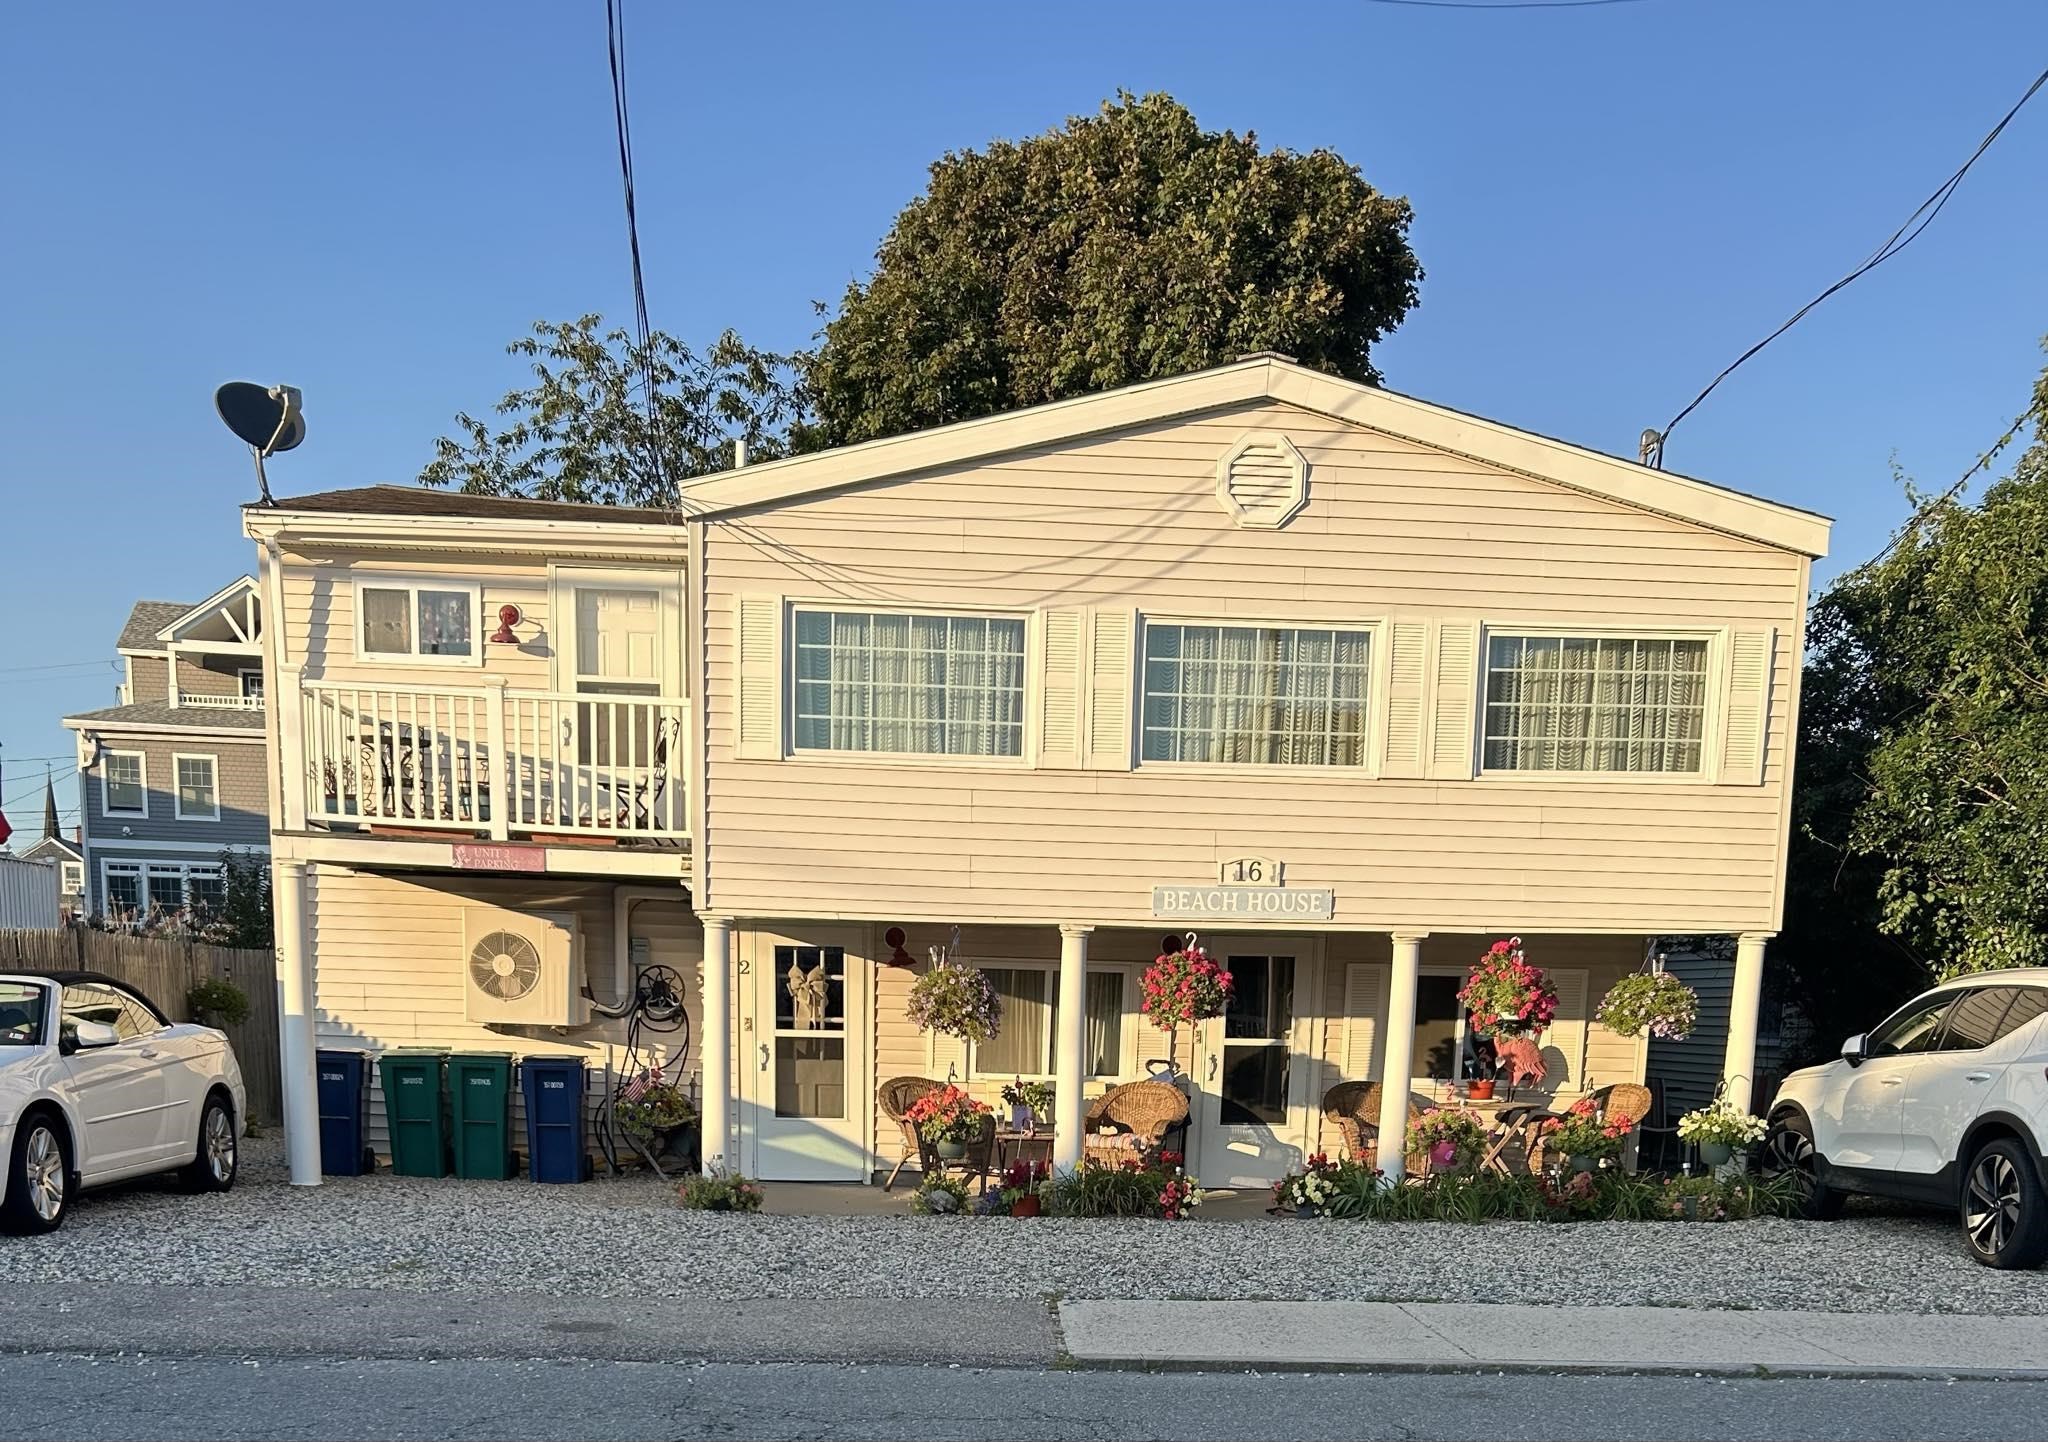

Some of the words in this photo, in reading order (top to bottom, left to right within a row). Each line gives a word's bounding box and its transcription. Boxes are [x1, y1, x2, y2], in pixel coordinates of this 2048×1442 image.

[474, 847, 502, 858] UNIT
[474, 858, 519, 870] PARKING
[1235, 860, 1263, 882] 16
[1162, 890, 1239, 912] BEACH
[1247, 892, 1323, 913] HOUSE
[739, 960, 750, 974] 2
